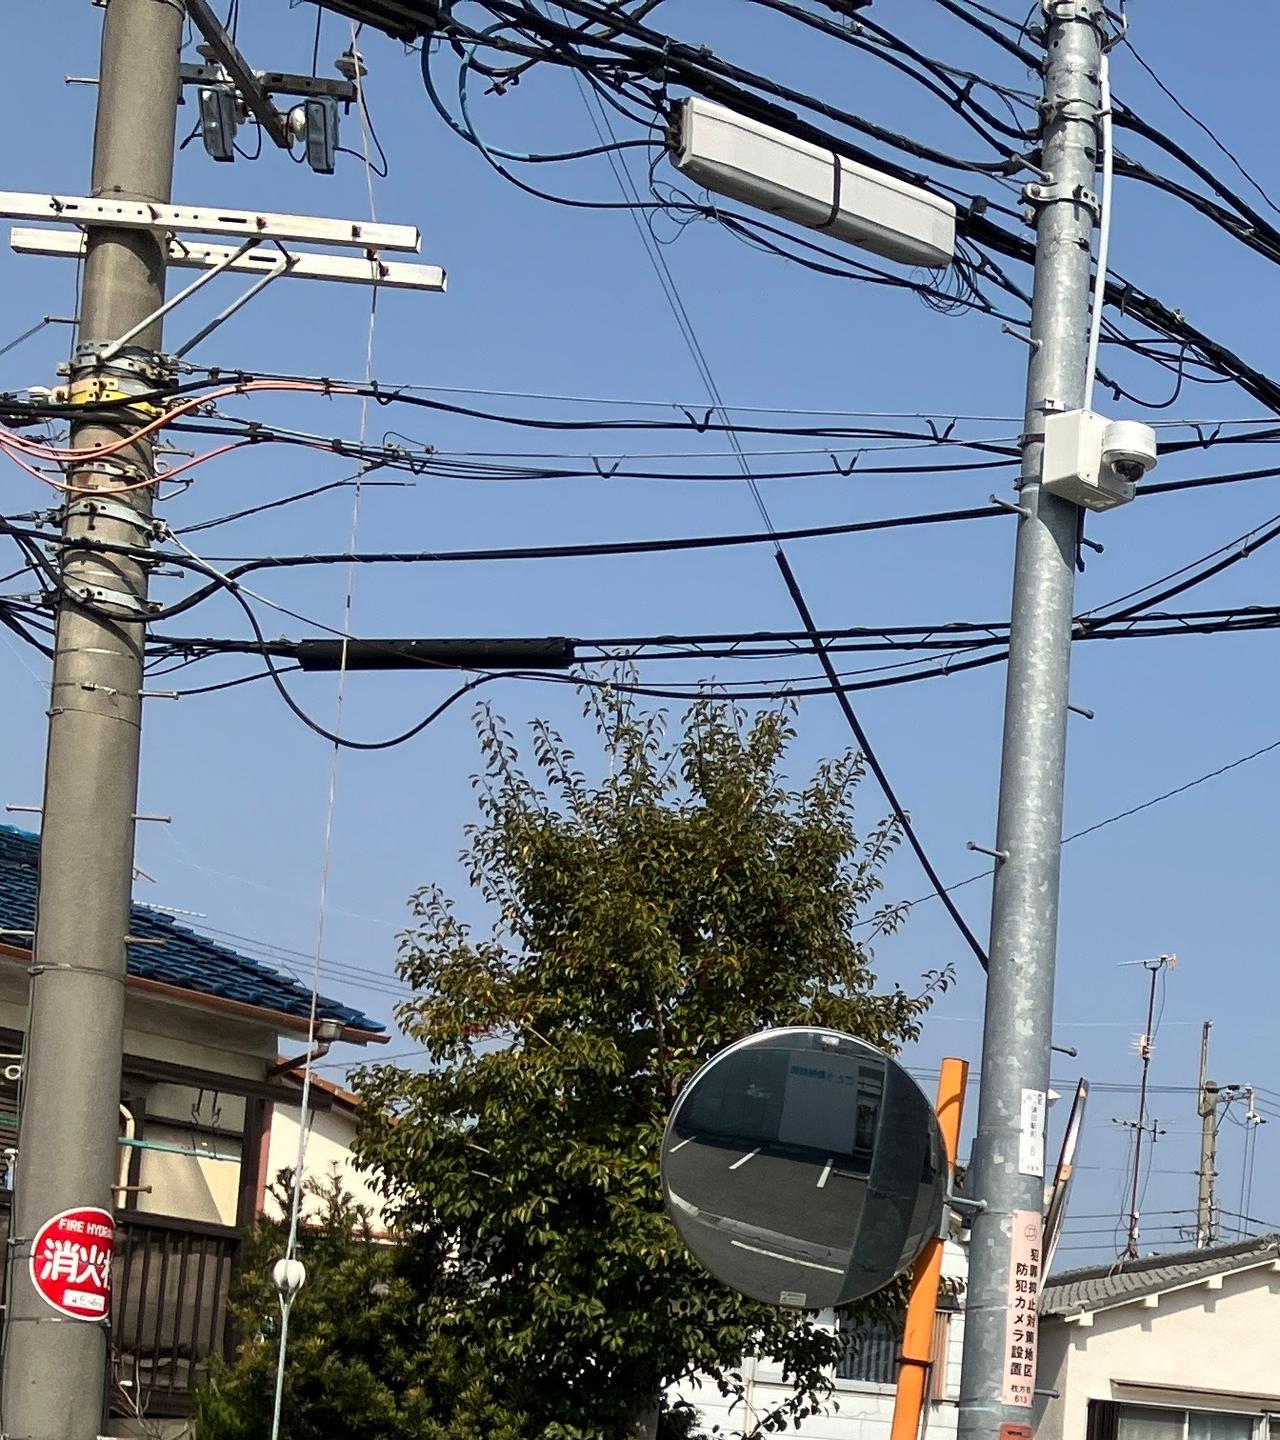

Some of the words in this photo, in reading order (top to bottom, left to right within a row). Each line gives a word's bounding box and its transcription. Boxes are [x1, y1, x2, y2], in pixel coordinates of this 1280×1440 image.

[59, 1218, 84, 1233] FIRE
[1010, 1262, 1029, 1376] 防犯カメラ設置
